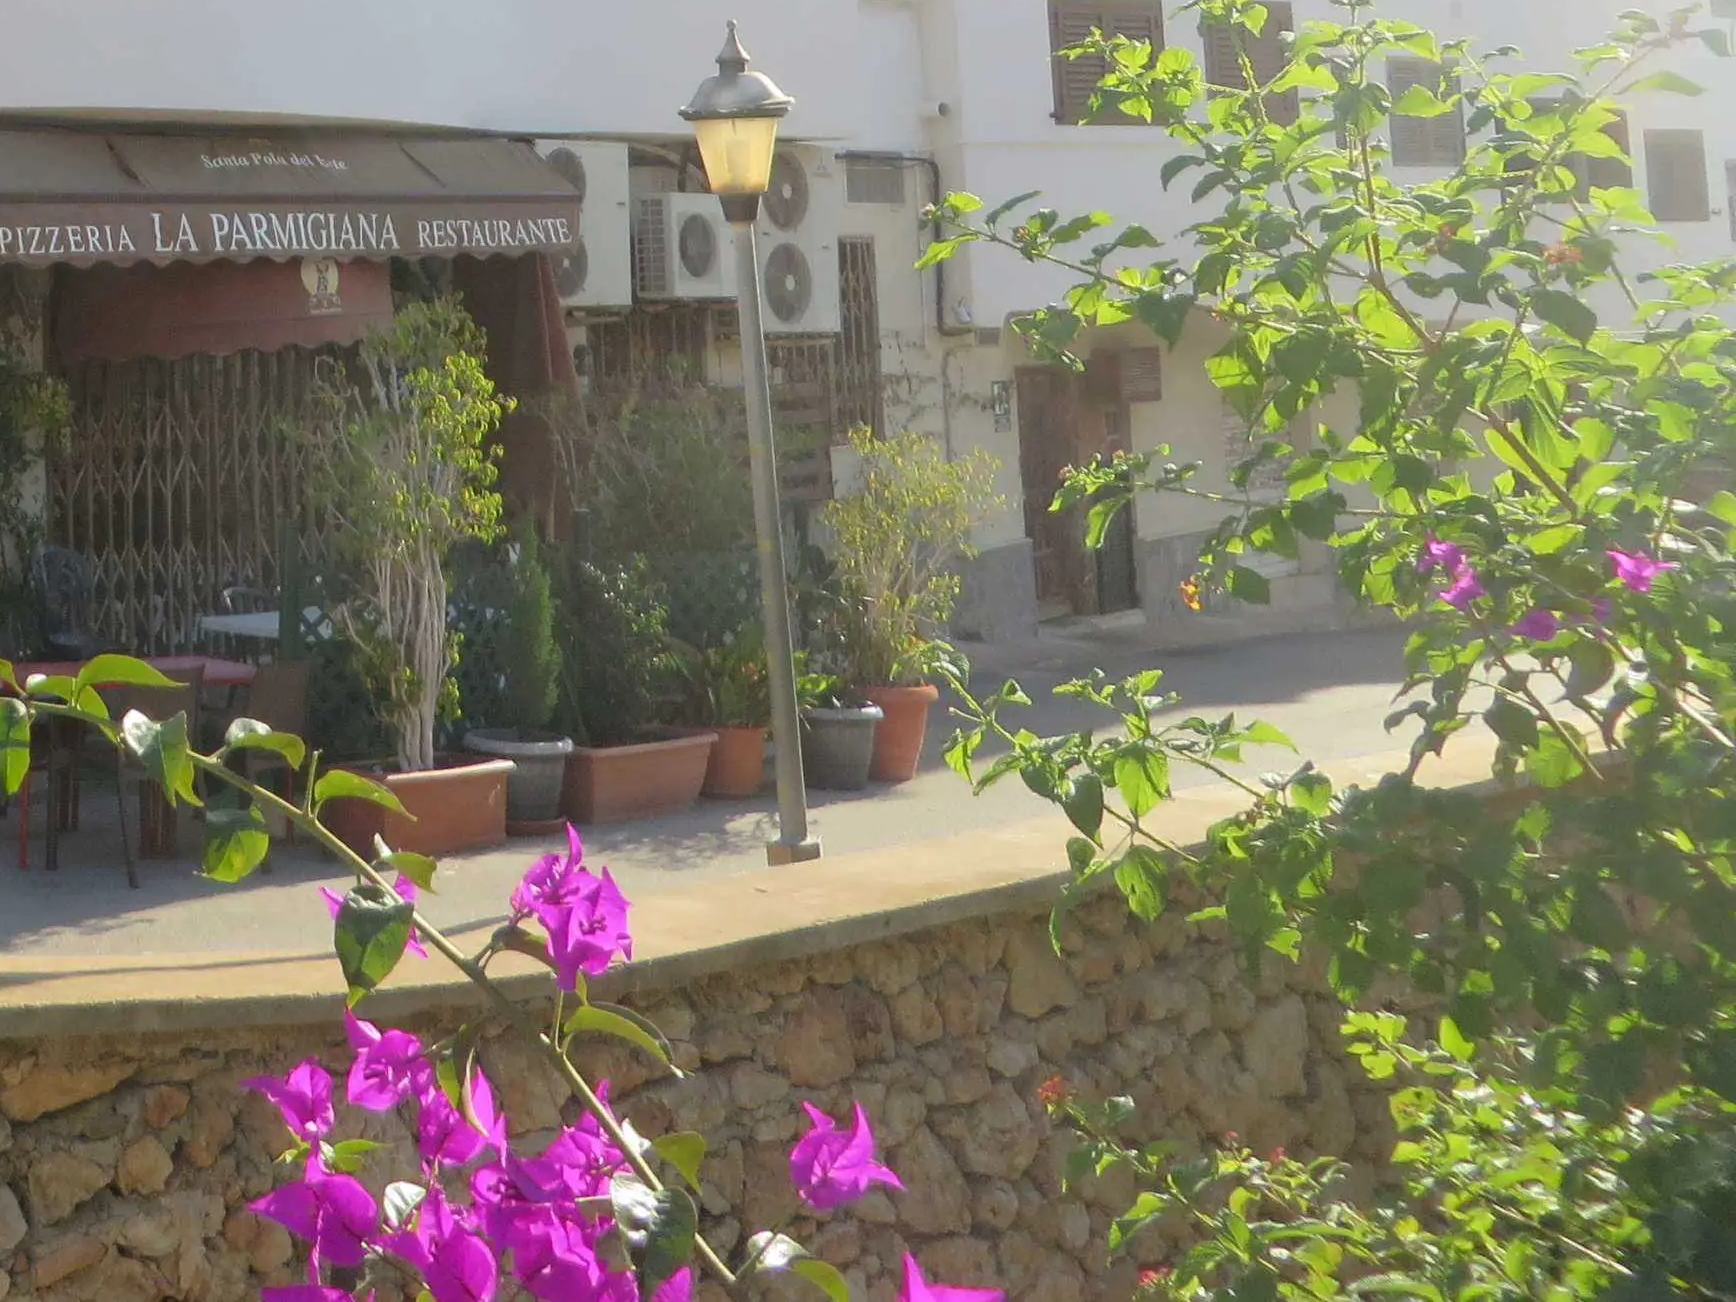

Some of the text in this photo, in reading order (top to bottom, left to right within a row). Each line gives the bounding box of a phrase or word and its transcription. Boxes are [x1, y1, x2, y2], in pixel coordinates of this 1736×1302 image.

[200, 153, 250, 169] Santa
[250, 152, 288, 166] Pola
[289, 152, 314, 167] del
[150, 212, 200, 253] LA
[207, 211, 401, 252] PARMIGIANA
[417, 217, 573, 248] RESTAURANTE
